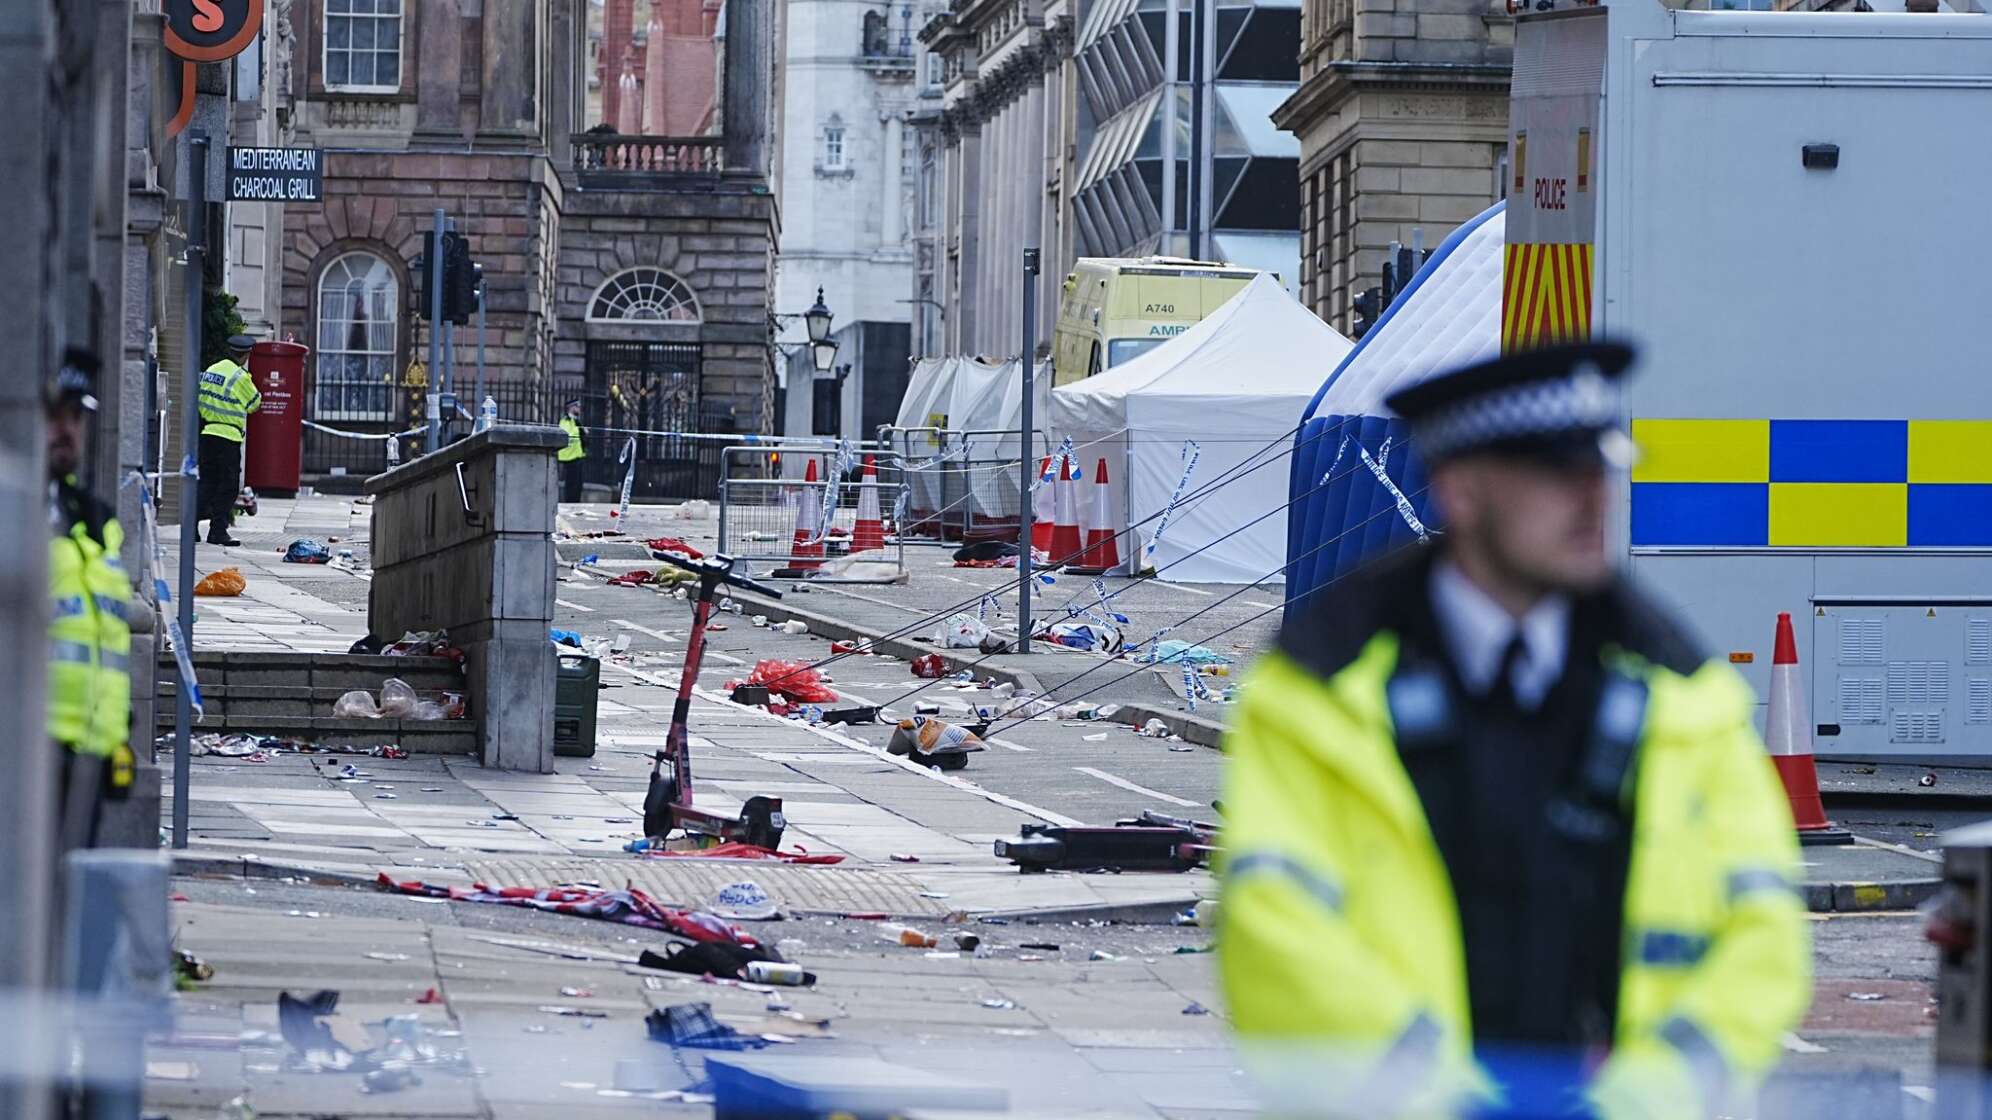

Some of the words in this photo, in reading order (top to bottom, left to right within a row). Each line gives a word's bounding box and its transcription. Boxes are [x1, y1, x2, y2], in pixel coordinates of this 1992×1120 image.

[192, 0, 224, 32] S
[233, 148, 316, 171] MEDITERRANEAN
[233, 177, 286, 198] CHARCOAL
[288, 178, 316, 199] GRILL
[1535, 178, 1566, 210] POLICE
[1145, 304, 1175, 313] A740
[204, 372, 223, 385] POLICE
